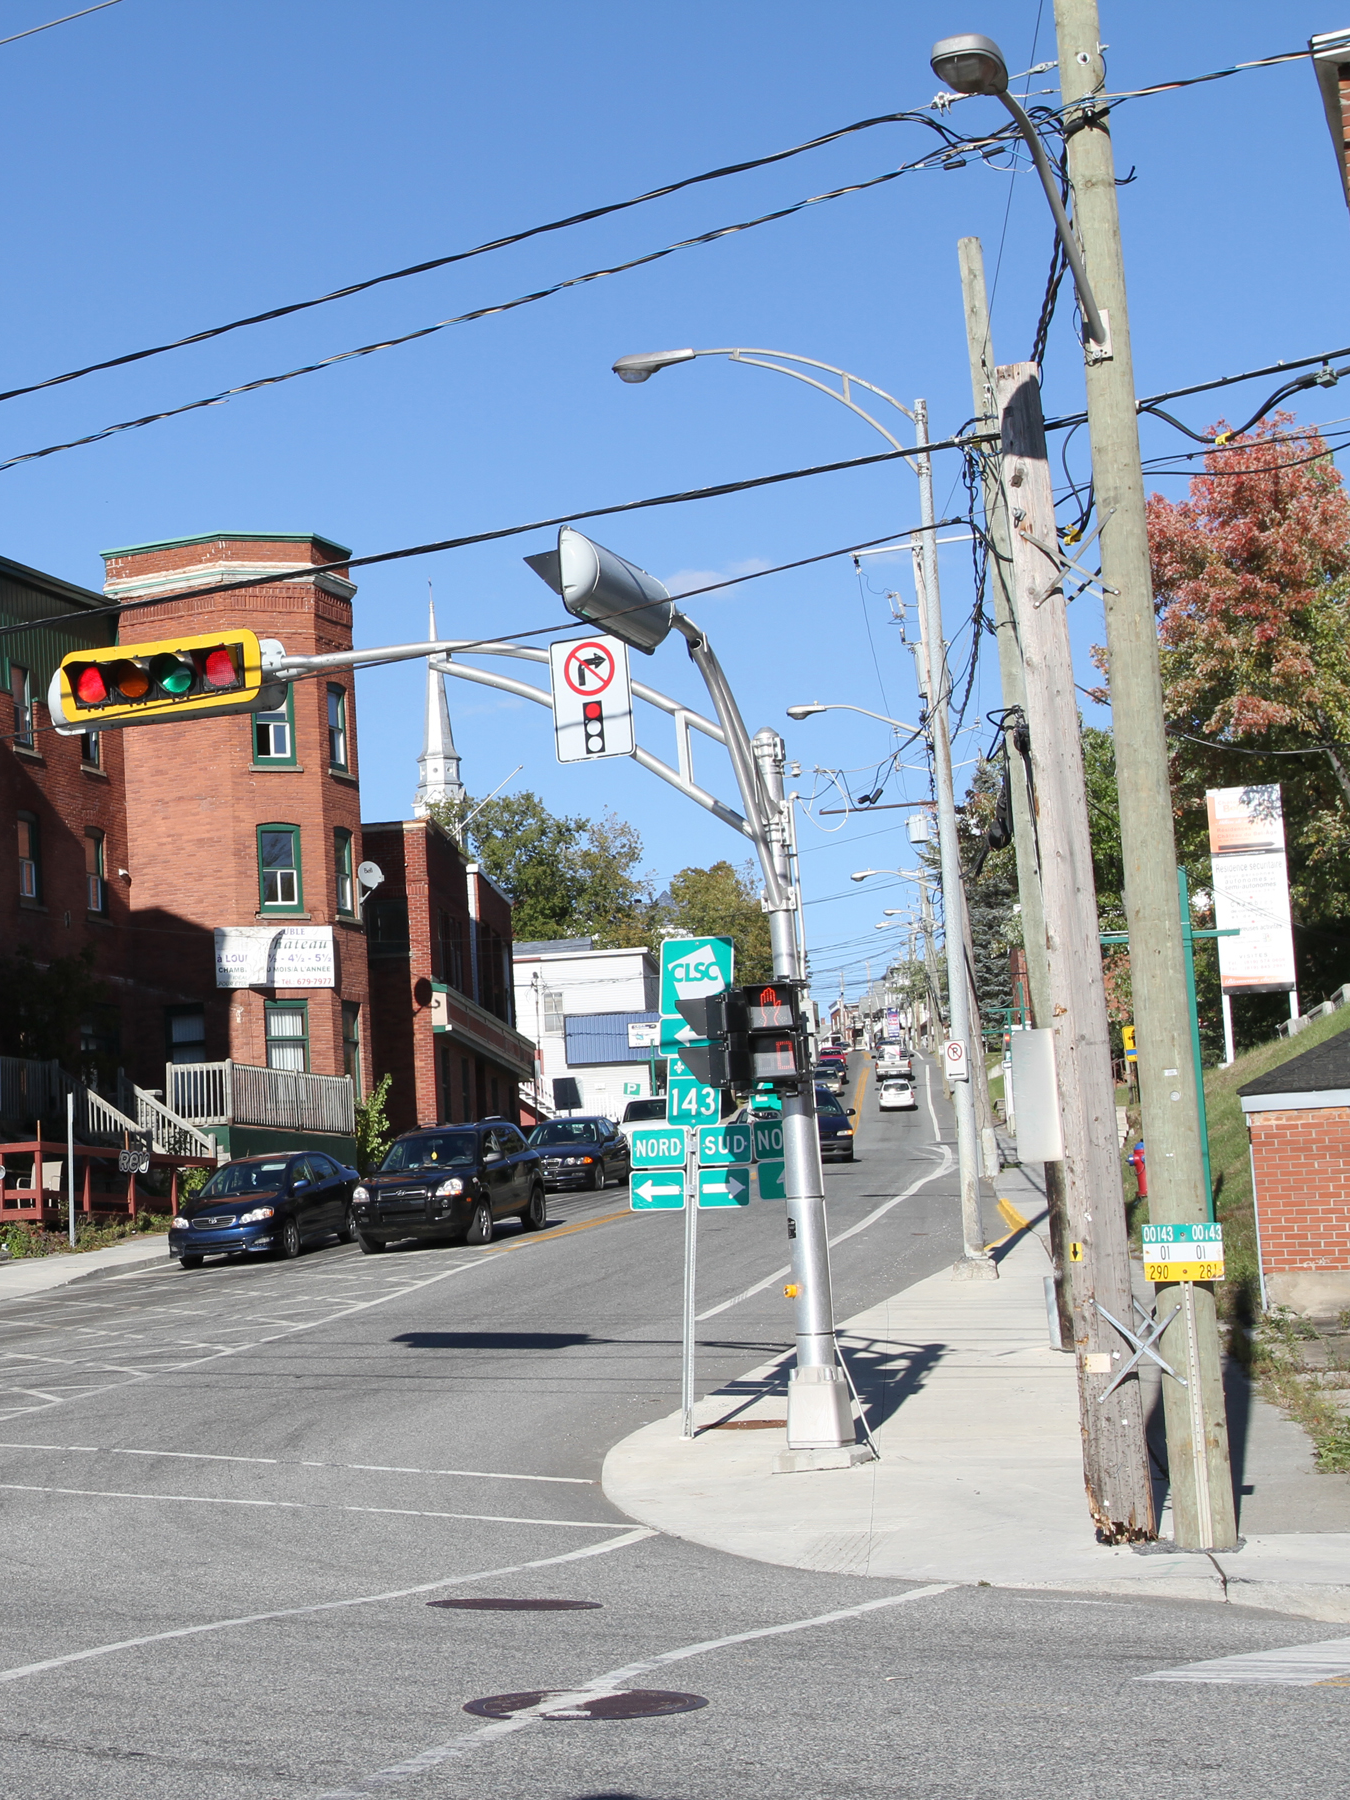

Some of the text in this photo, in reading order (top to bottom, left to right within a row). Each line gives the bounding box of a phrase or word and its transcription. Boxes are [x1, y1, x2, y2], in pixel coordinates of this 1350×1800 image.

[670, 962, 718, 982] CLSC
[671, 1087, 716, 1116] 143
[636, 1138, 682, 1157] NORD
[704, 1135, 746, 1155] SUD
[758, 1128, 783, 1150] NO
[1143, 1225, 1173, 1242] 00143
[1160, 1244, 1206, 1260] 01 01
[1150, 1264, 1168, 1280] 290
